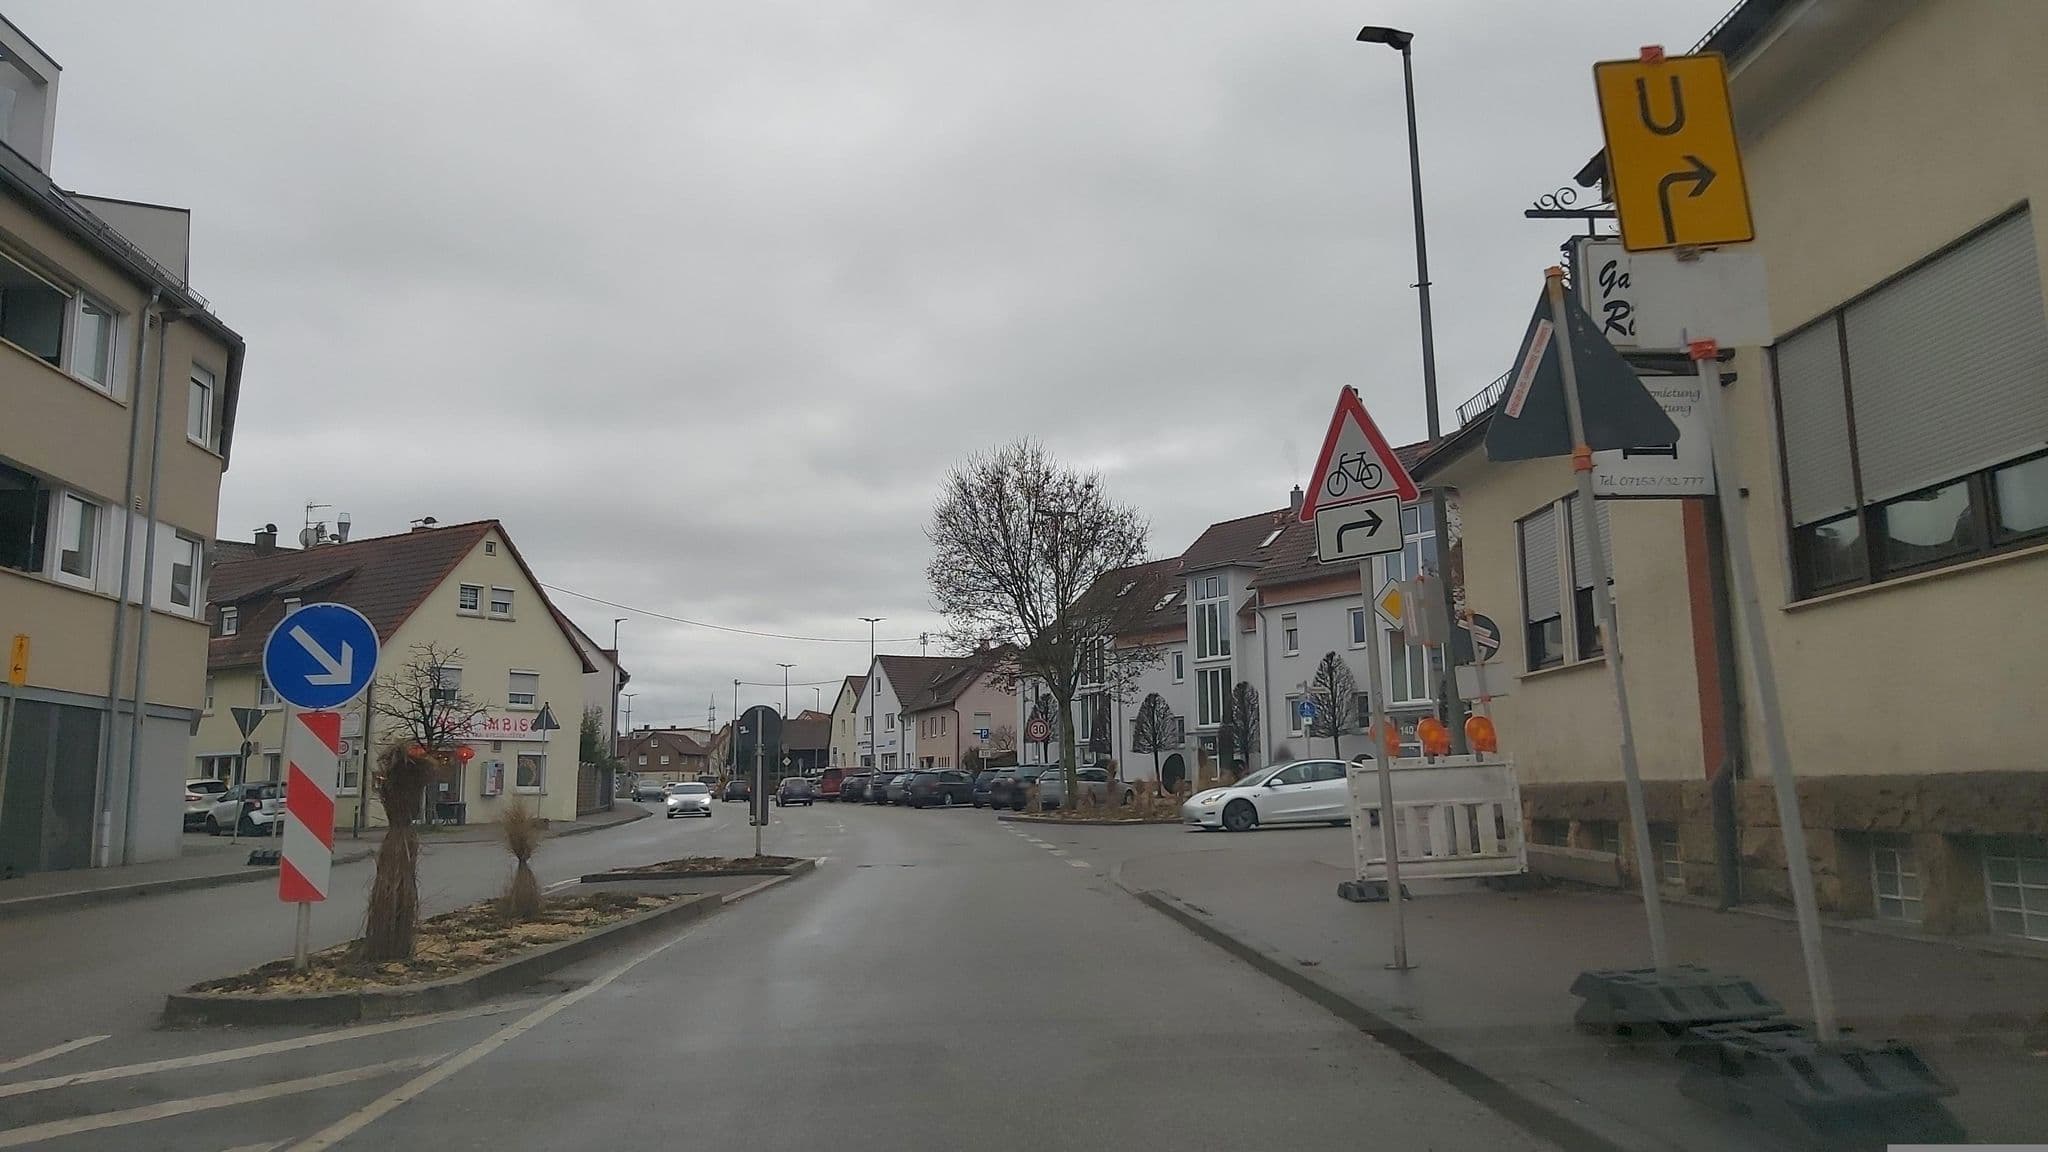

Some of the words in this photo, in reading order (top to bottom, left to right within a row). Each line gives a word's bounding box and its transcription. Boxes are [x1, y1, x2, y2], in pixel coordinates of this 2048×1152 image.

[1636, 75, 1685, 136] U
[1599, 260, 1631, 298] Ga
[1603, 300, 1635, 336] Ri
[1033, 724, 1045, 734] 30
